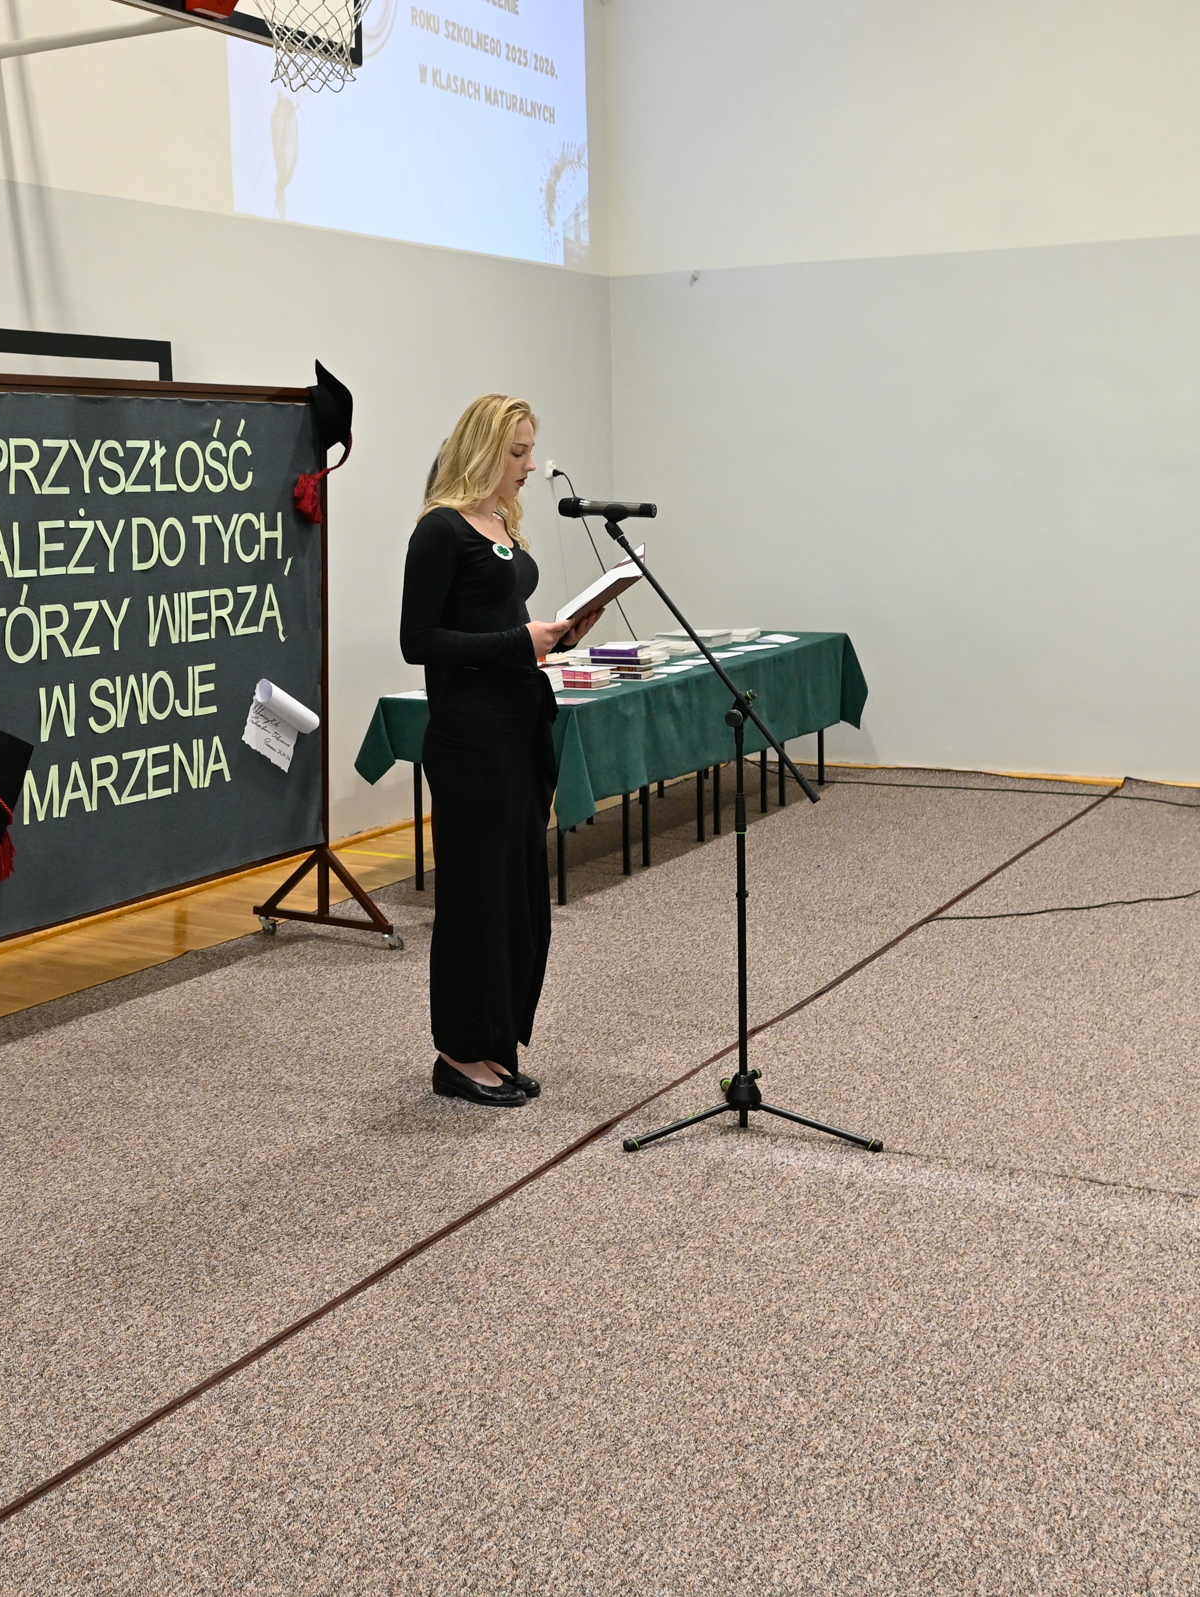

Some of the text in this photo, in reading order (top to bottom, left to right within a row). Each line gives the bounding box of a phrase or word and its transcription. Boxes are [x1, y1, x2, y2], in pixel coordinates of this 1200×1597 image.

[411, 6, 440, 35] ROKU
[445, 19, 502, 58] SZKOLNEGO
[419, 63, 556, 125] W KLASACH MATURALNYCH
[131, 517, 186, 571] DO
[191, 512, 293, 576] TYCH,
[148, 584, 286, 647] WIERZĄ
[38, 682, 76, 743] W
[88, 663, 218, 734] SWOJE
[23, 735, 232, 826] MARZENIA
